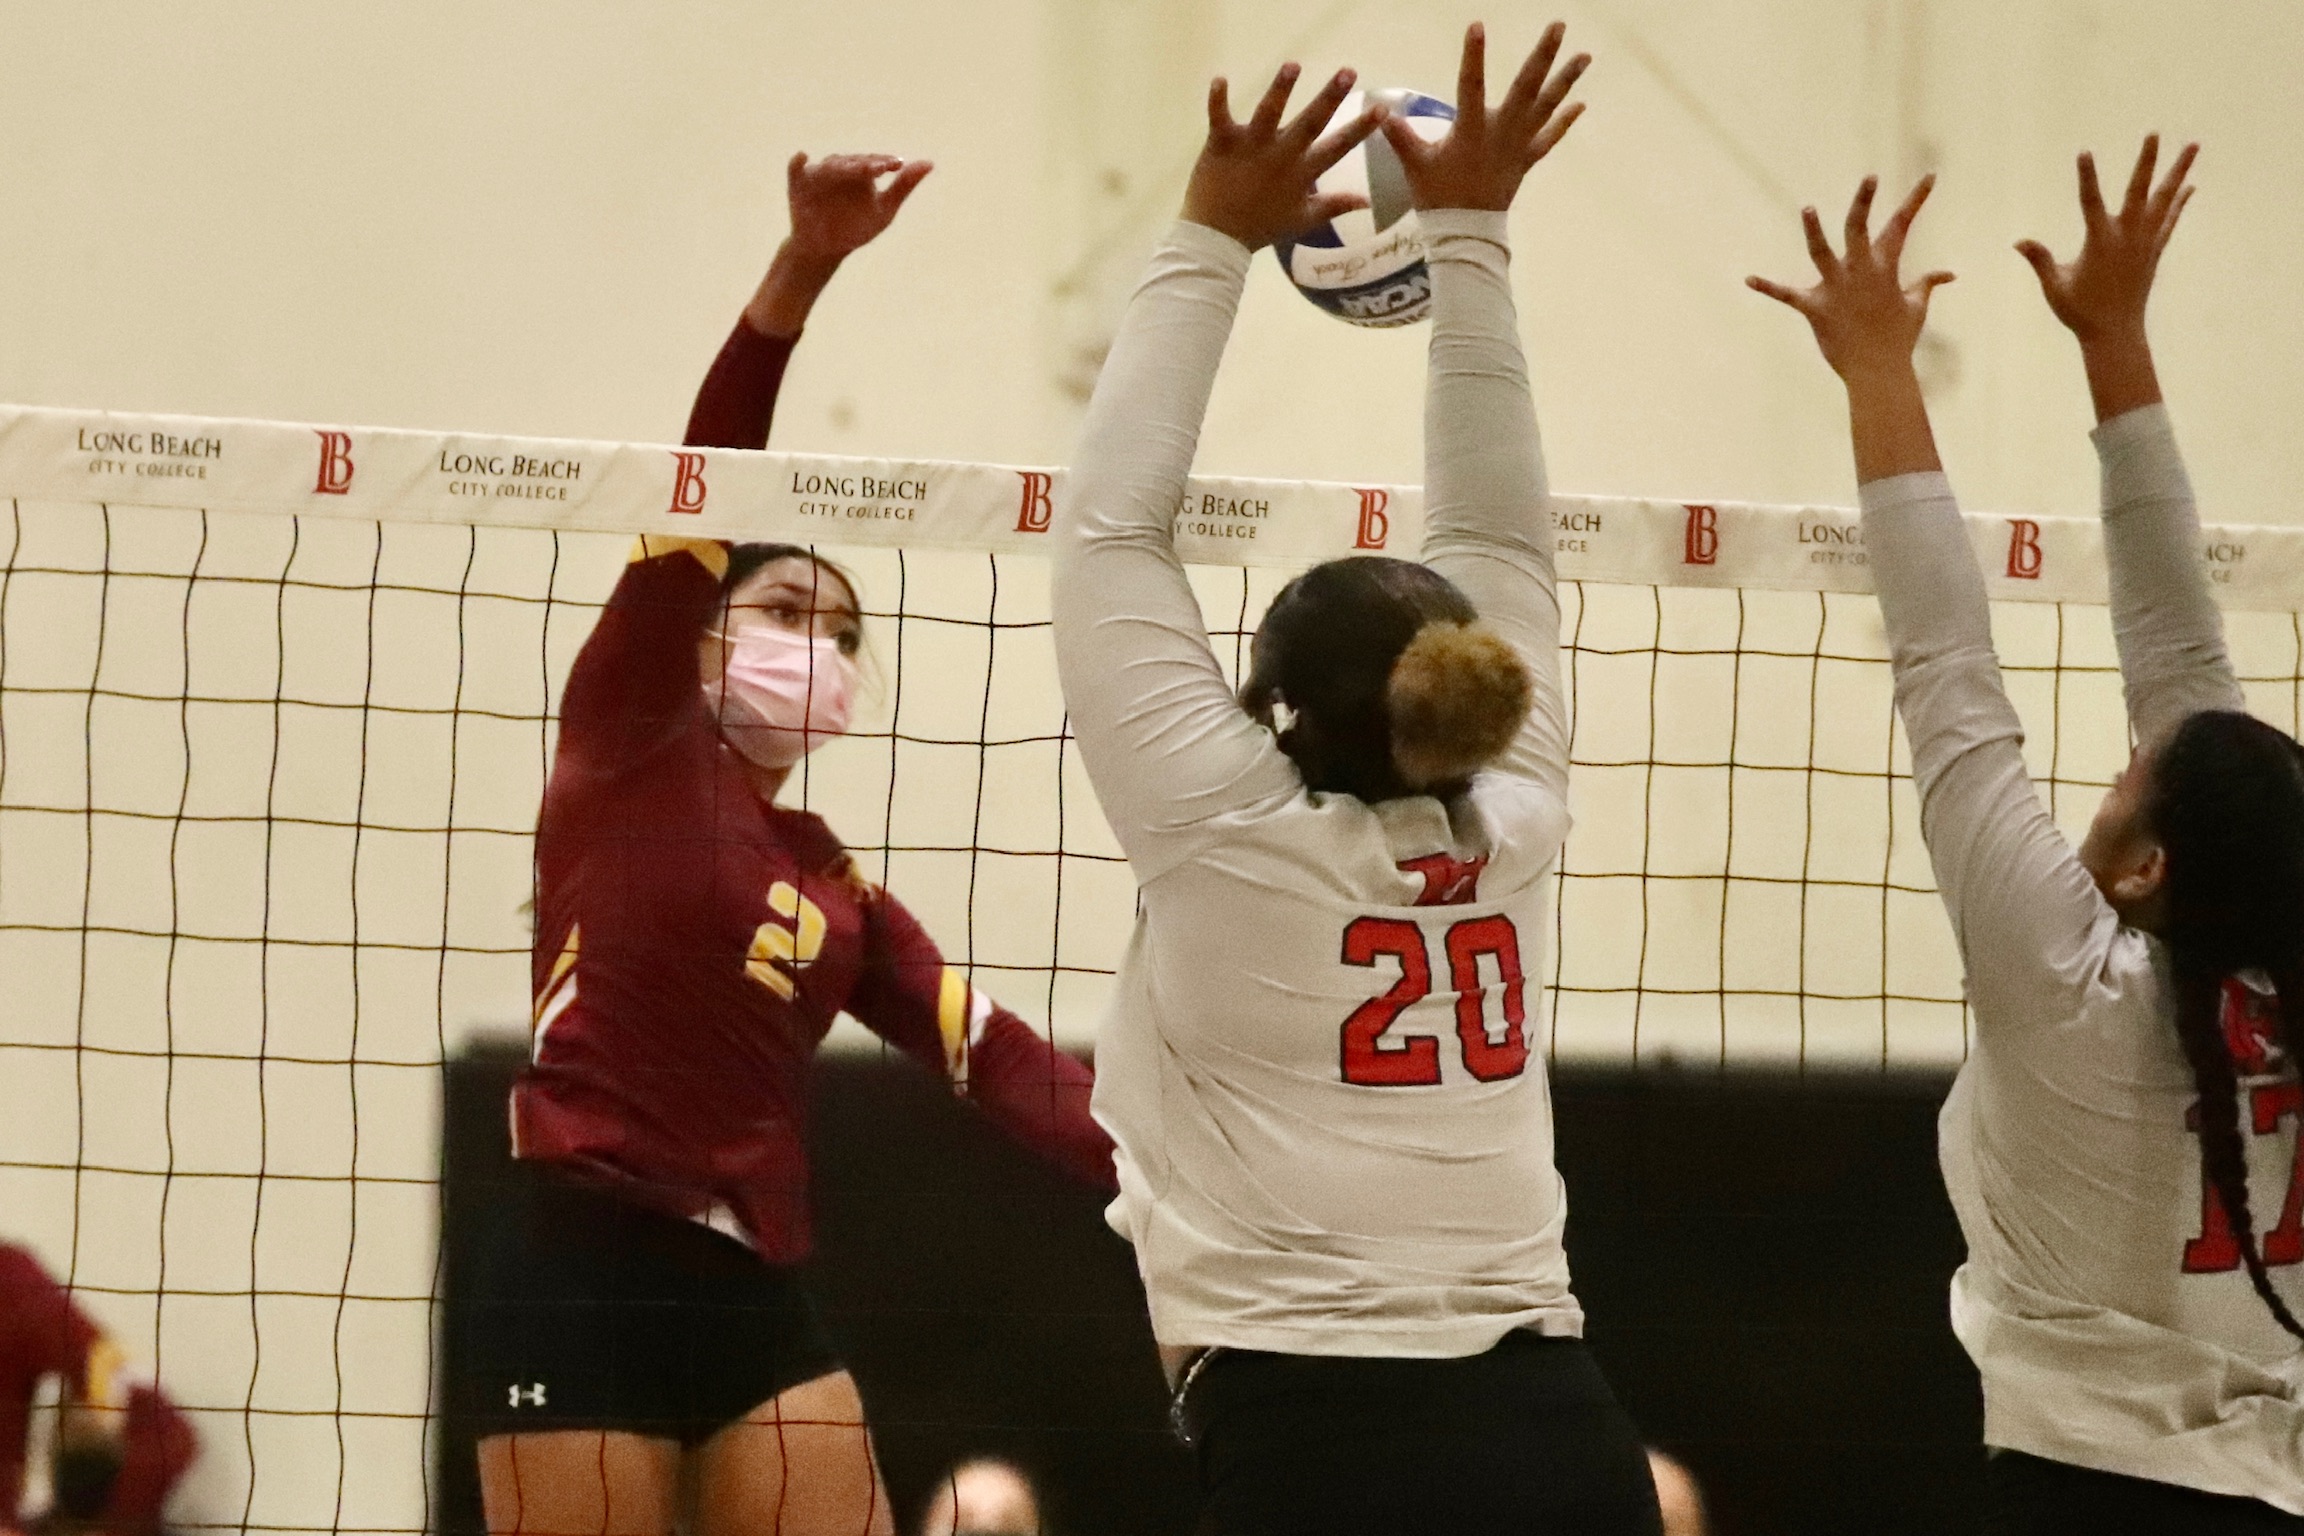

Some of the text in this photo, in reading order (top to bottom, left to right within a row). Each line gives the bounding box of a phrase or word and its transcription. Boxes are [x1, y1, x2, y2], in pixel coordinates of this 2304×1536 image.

[78, 428, 221, 459] LONG BEACH
[136, 462, 207, 479] COLLEGE
[440, 450, 580, 479] LONG BEACH
[449, 481, 567, 501] CITY COLLEGE
[792, 472, 927, 501] LONG BEACH
[799, 502, 915, 521] CITY COLLEGE
[1201, 494, 1268, 519] BEACH
[1188, 522, 1257, 539] COLLEGE
[1551, 512, 1601, 532] EACH
[1341, 913, 1530, 1086] 20
